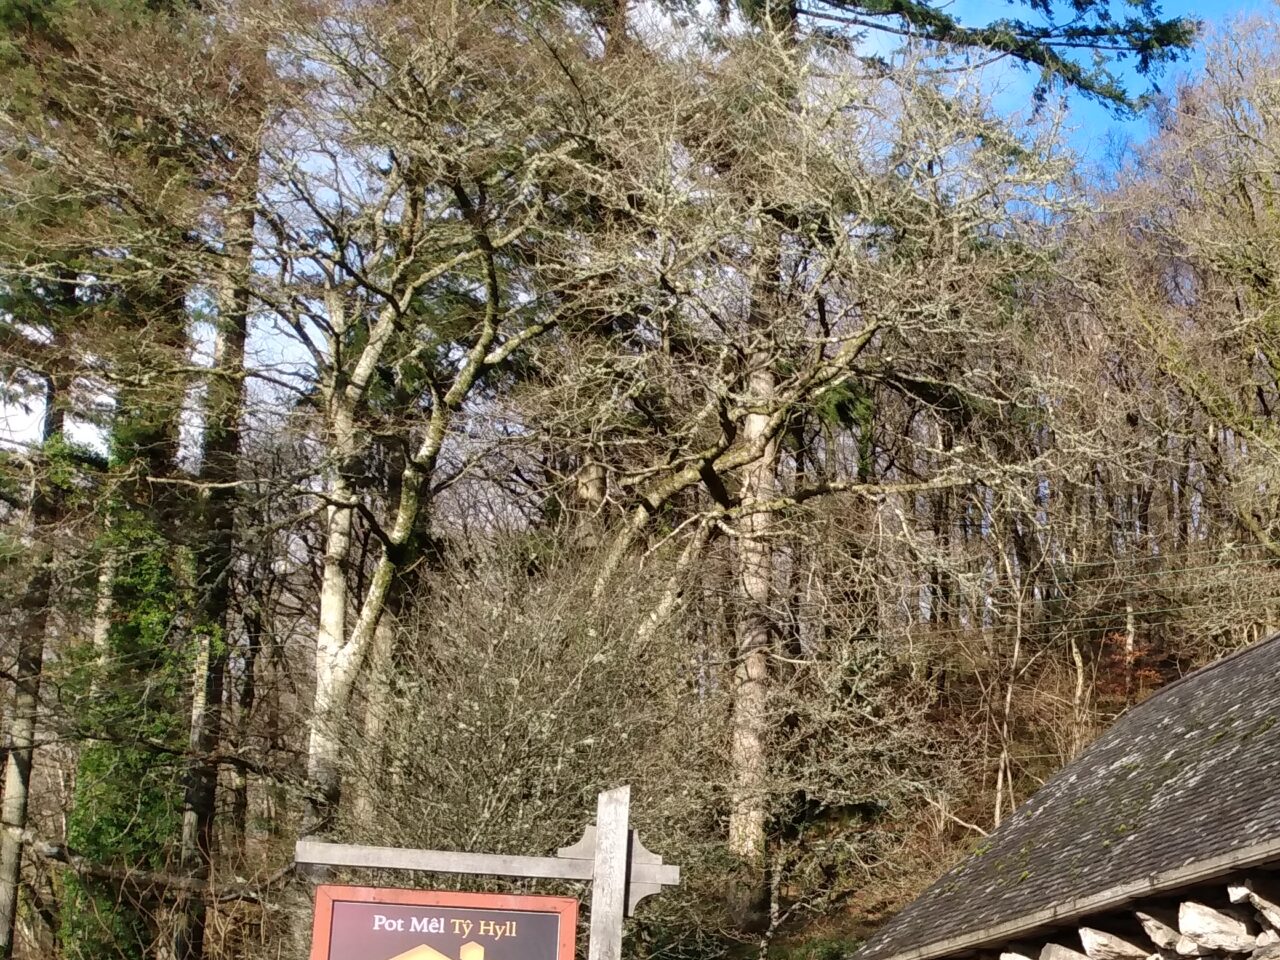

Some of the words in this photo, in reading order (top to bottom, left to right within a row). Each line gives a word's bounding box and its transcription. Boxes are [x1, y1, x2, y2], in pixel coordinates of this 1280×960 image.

[373, 915, 404, 932] Pot
[409, 917, 445, 933] Mêl
[451, 918, 474, 938] Tŷ
[479, 920, 517, 940] Hyll
